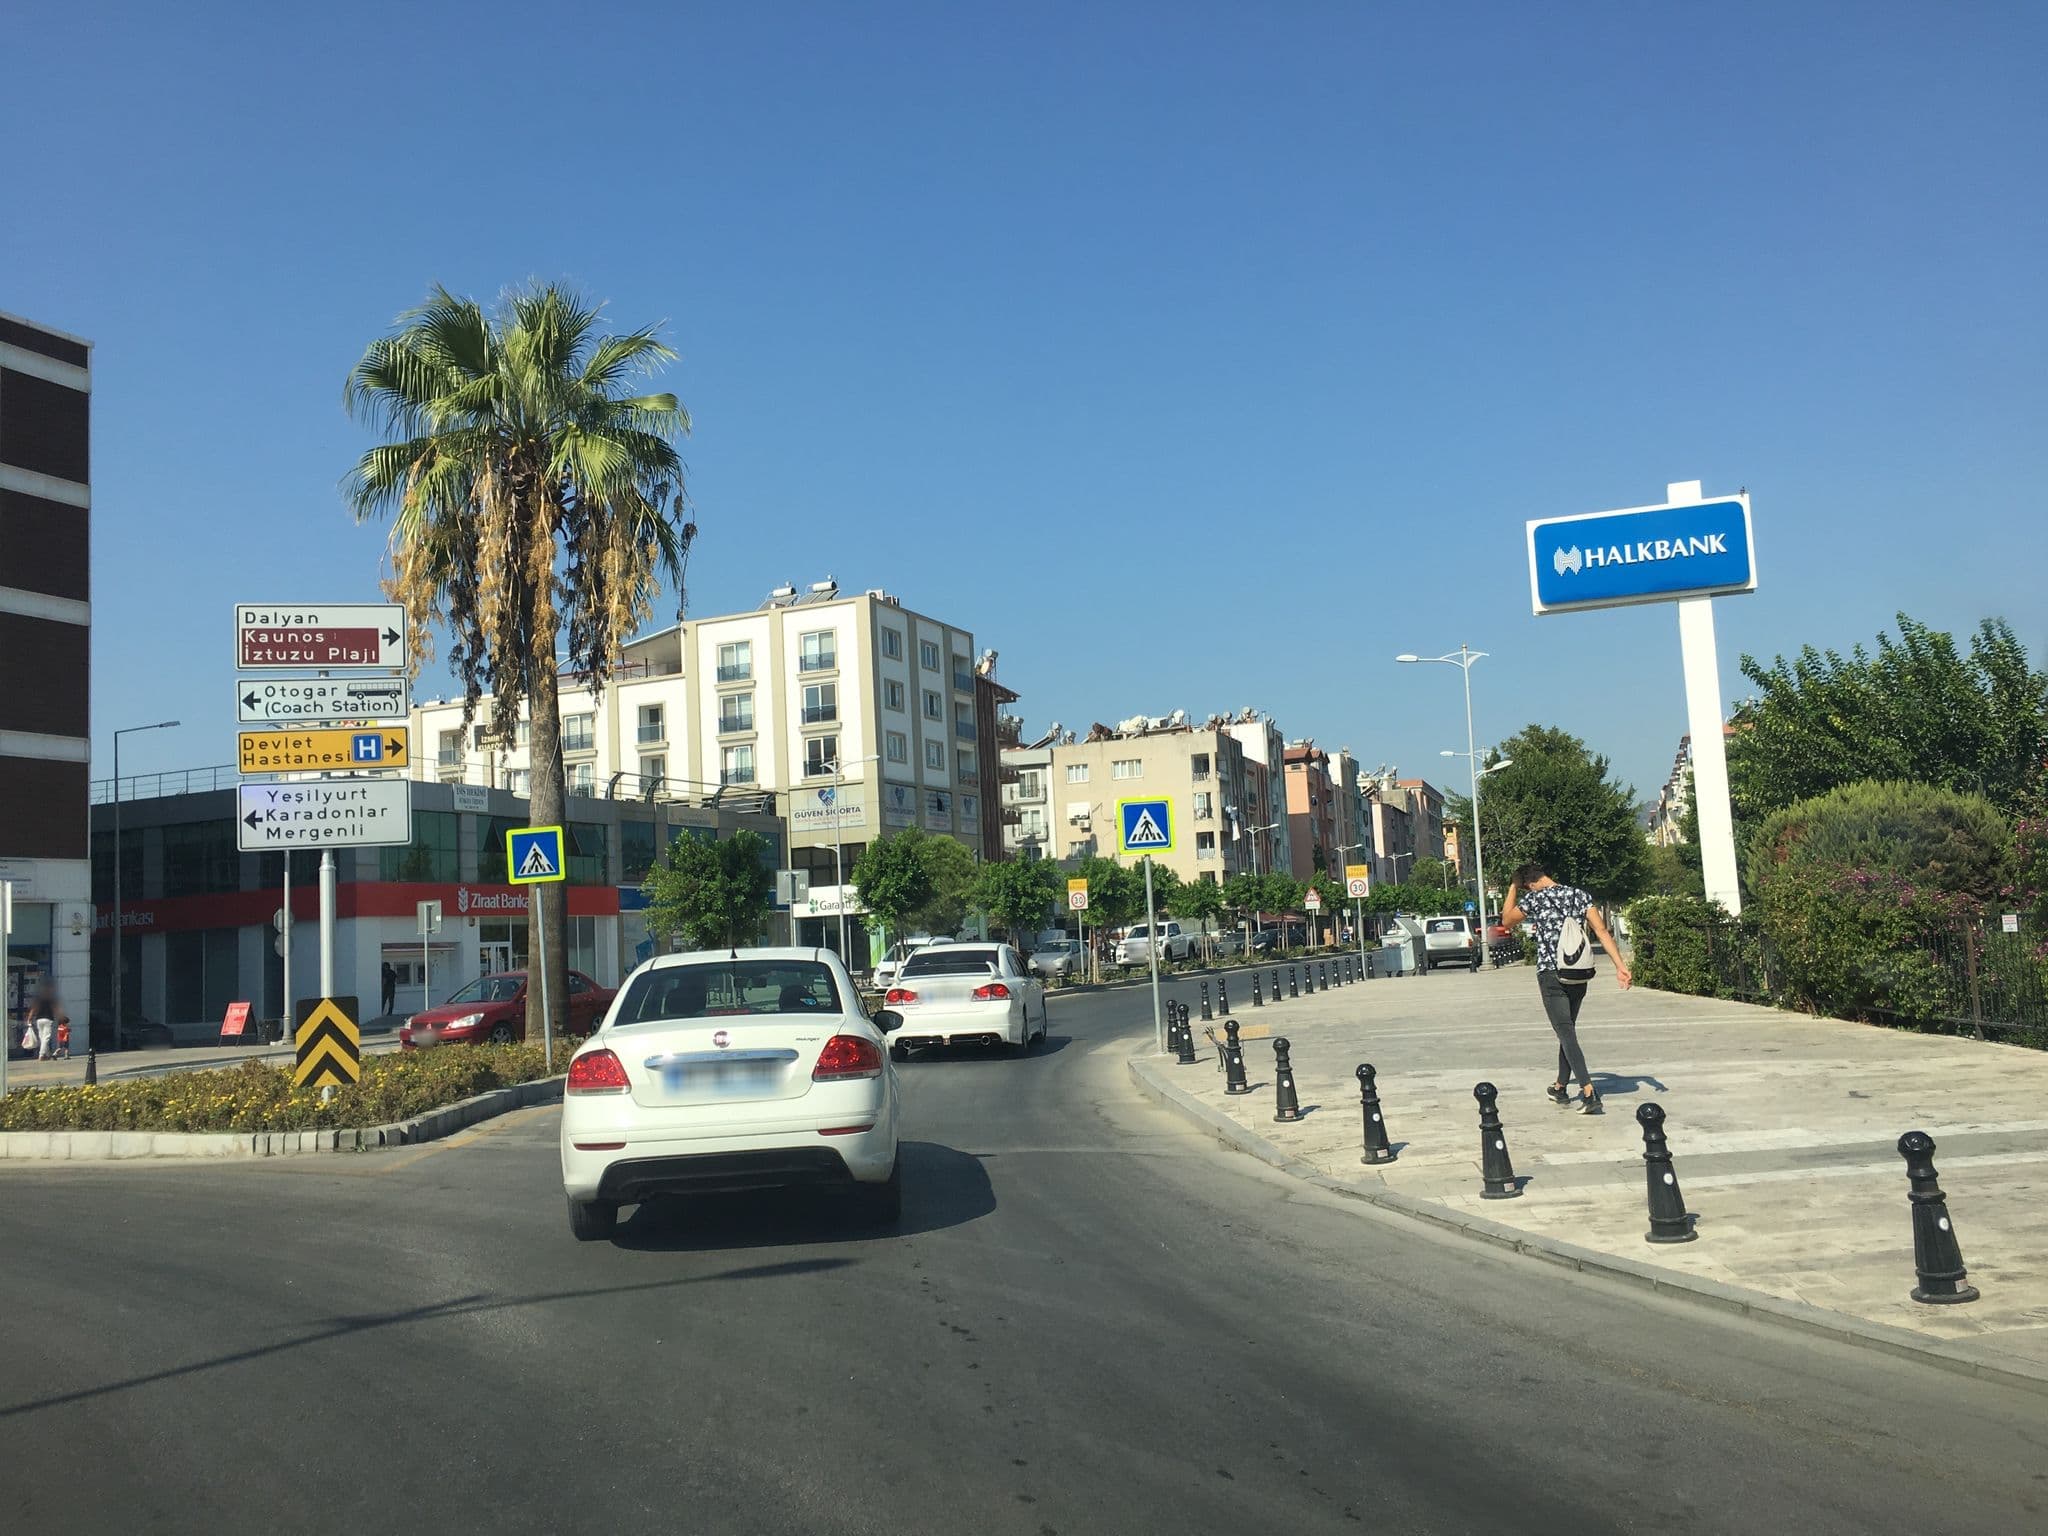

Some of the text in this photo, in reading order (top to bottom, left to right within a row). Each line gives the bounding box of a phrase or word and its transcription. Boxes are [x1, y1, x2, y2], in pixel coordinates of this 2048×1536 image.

[1585, 532, 1728, 568] HALKBANK
[244, 611, 319, 627] Dalyan
[244, 629, 325, 643] Kaunos
[244, 644, 376, 664] İztuzu Plajı
[264, 685, 338, 699] Otogar
[264, 699, 399, 717] (Coach Station)
[243, 736, 313, 751] Devlet
[358, 738, 377, 759] H
[243, 750, 351, 766] Hastanesi
[266, 787, 368, 805] Yeşilyurt
[265, 806, 388, 822] Karadonlar
[266, 823, 364, 841] Mergenli
[1352, 883, 1364, 893] 30
[470, 893, 501, 908] Ziraat
